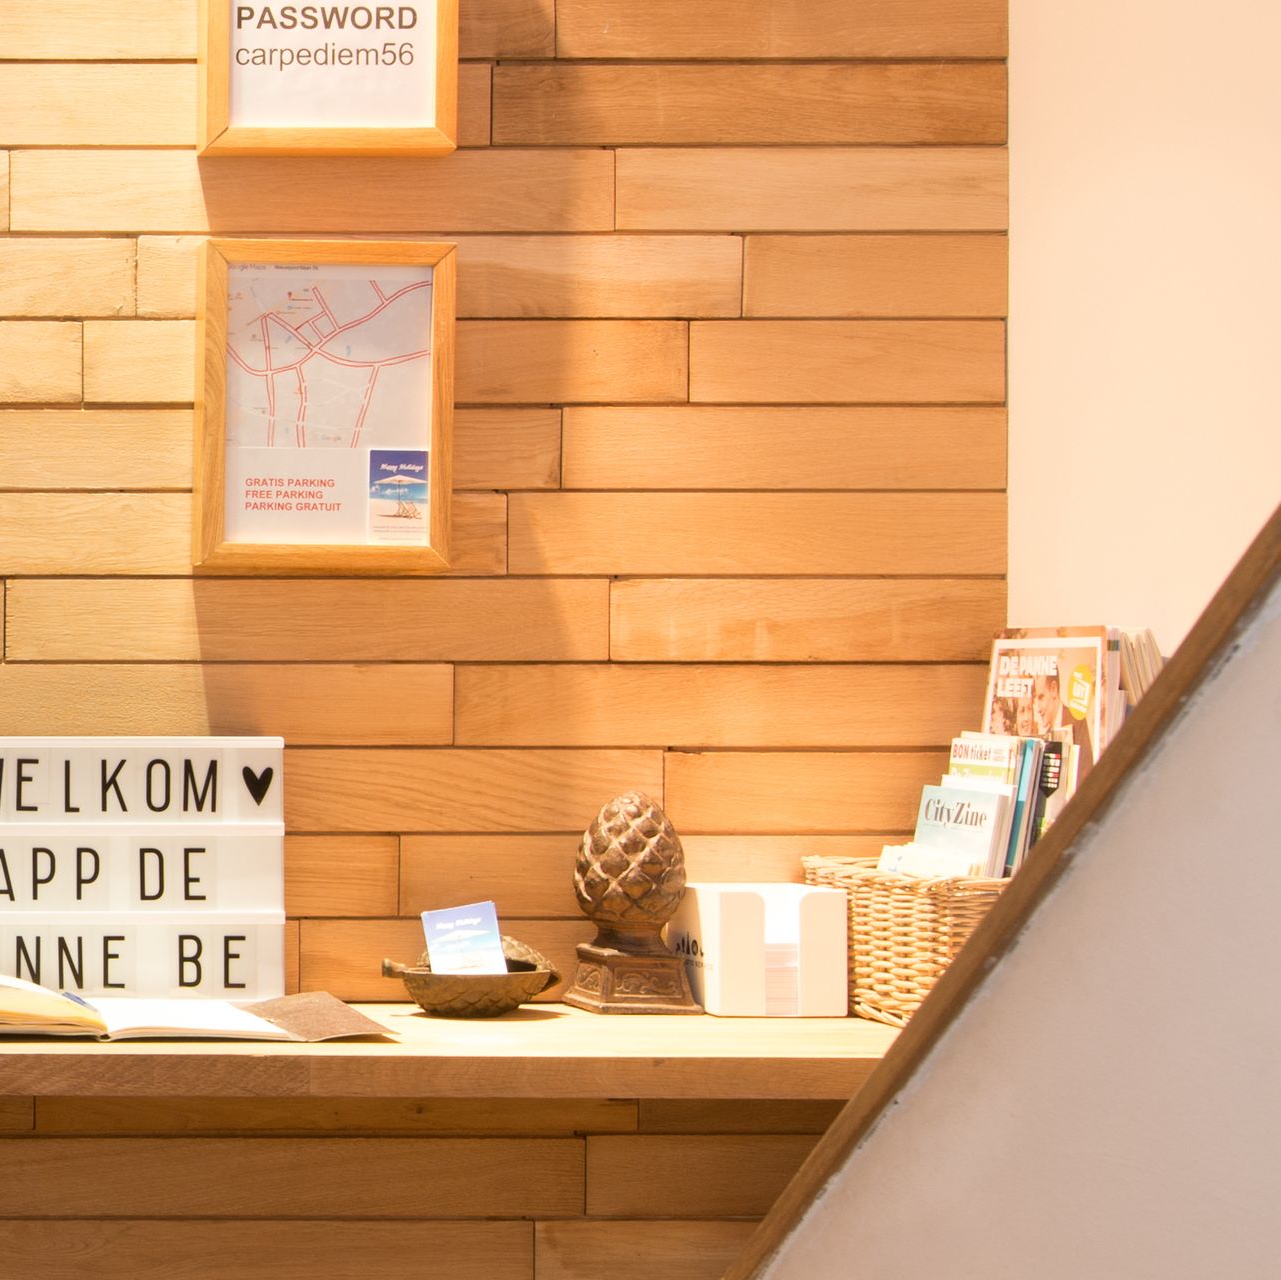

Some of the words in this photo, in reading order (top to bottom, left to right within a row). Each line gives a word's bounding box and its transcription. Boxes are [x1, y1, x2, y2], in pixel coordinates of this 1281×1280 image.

[237, 6, 417, 30] PASSWORD
[235, 42, 414, 72] carpediem56
[245, 478, 285, 487] GRATIS
[287, 478, 335, 488] PARKING
[245, 490, 272, 499] FREE
[275, 490, 323, 499] PARKING
[245, 502, 293, 511] PARKING
[295, 502, 342, 512] GRATUIT
[1000, 655, 1018, 675] DE
[1019, 655, 1058, 676] PANNE
[997, 677, 1034, 698] LEEFT
[952, 743, 969, 759] BON
[924, 798, 988, 829] CityZine
[139, 847, 207, 901] DE
[177, 934, 246, 988] BE
